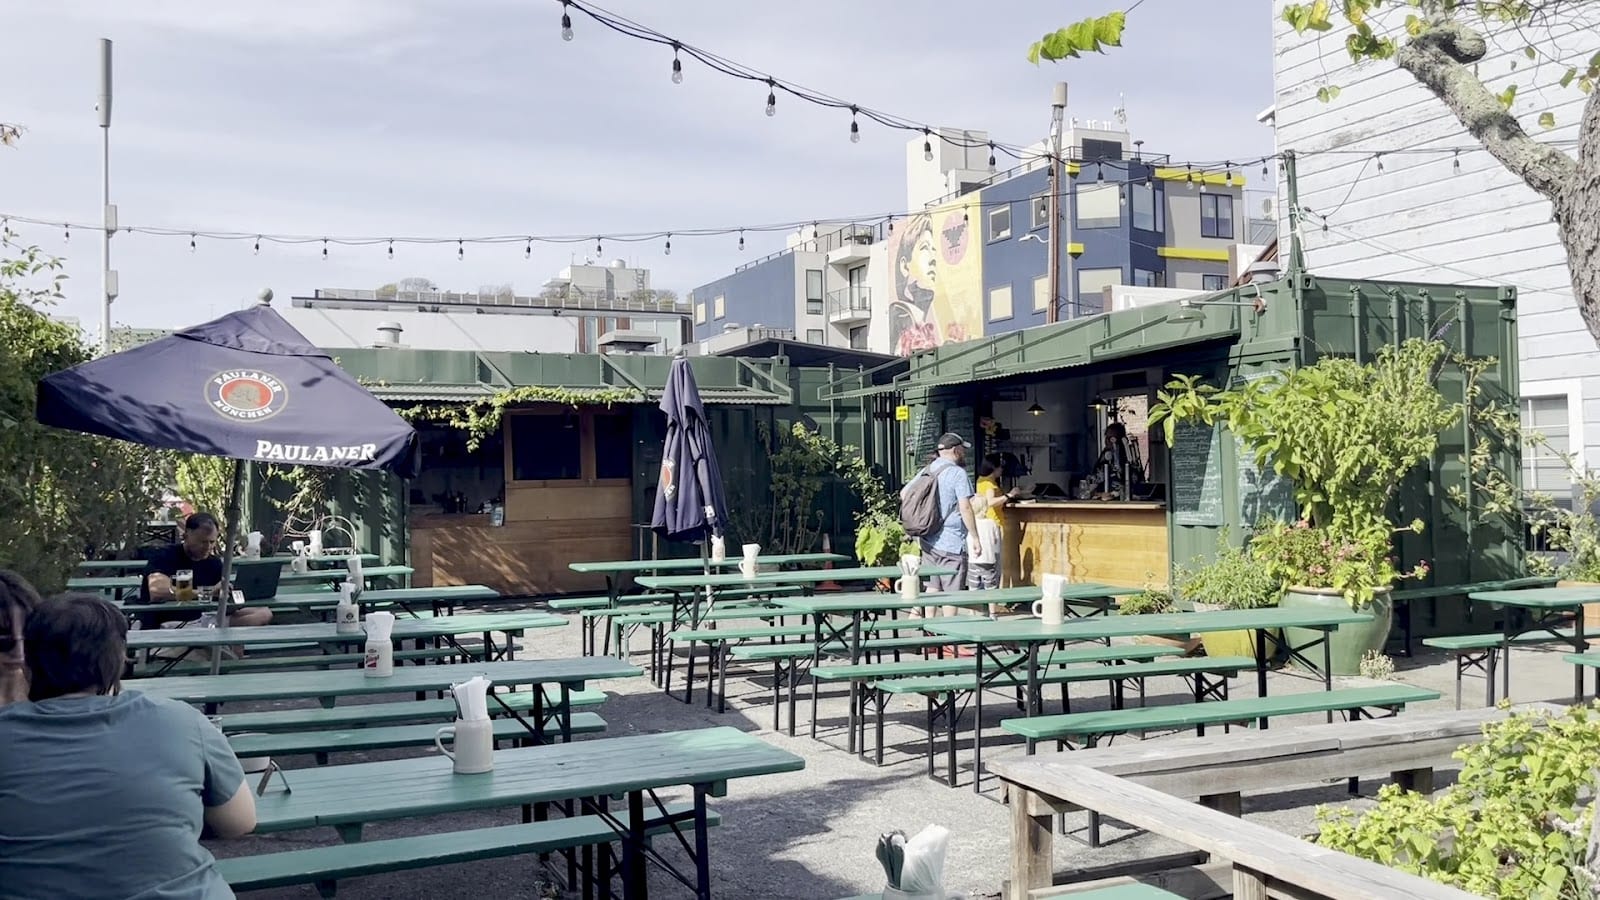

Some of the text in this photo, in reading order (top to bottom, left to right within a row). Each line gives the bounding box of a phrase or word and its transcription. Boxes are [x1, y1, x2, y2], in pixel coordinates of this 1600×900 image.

[214, 371, 282, 393] PAULANER
[213, 399, 273, 419] MÜNCHEN
[254, 439, 377, 462] PAULANER
